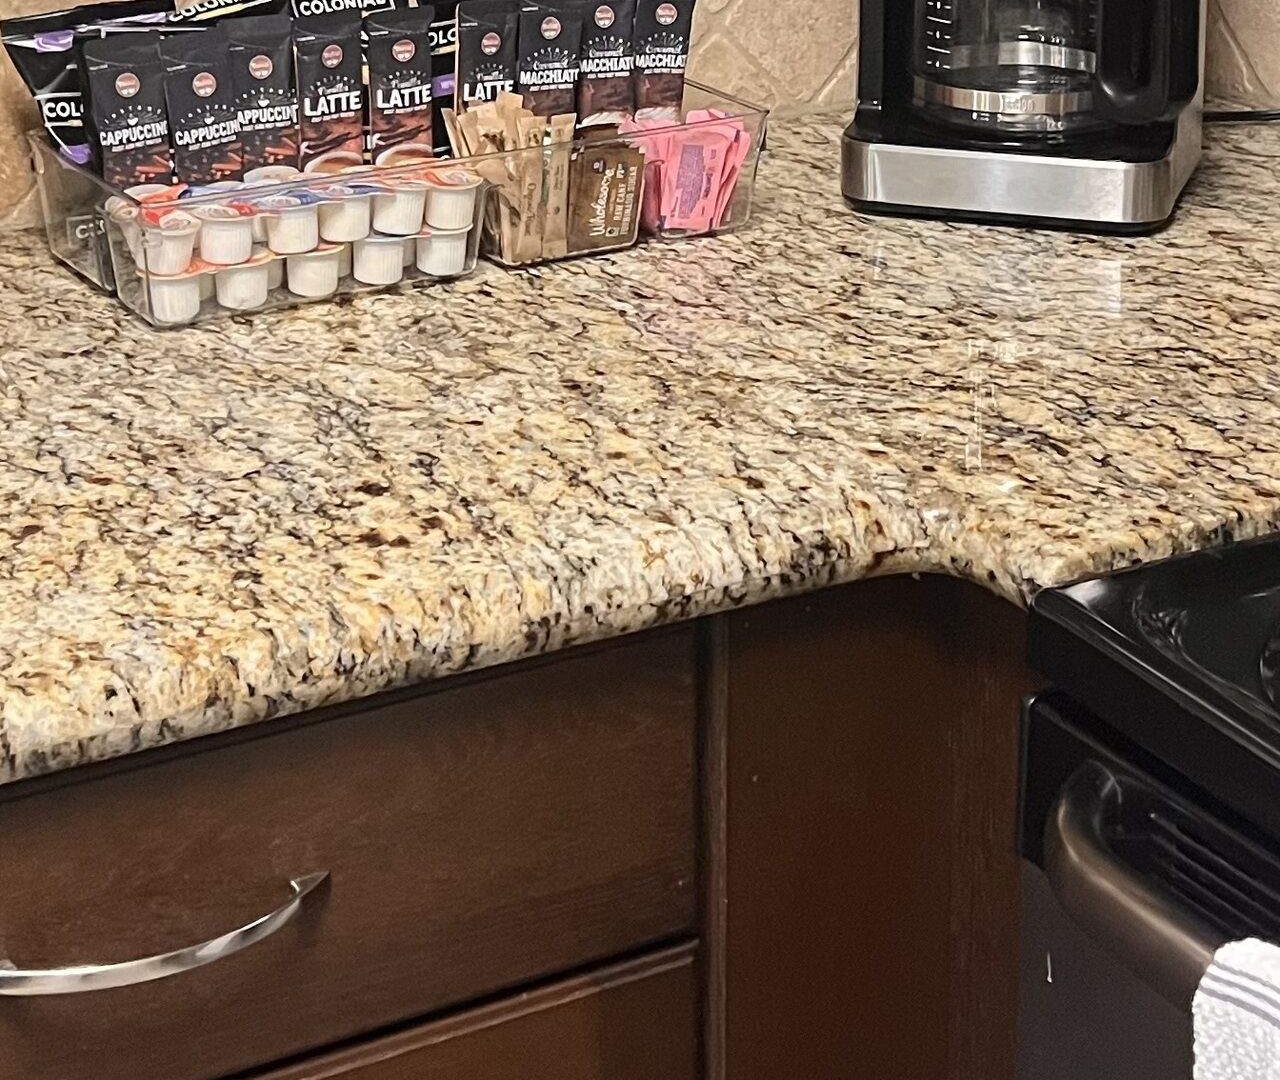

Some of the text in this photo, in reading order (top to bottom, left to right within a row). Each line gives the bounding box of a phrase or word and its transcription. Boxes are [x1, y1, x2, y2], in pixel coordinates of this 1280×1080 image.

[304, 90, 362, 116] LATTE
[377, 83, 433, 109] LATTE
[463, 80, 514, 102] LATTE
[589, 168, 616, 236] Wholesome
